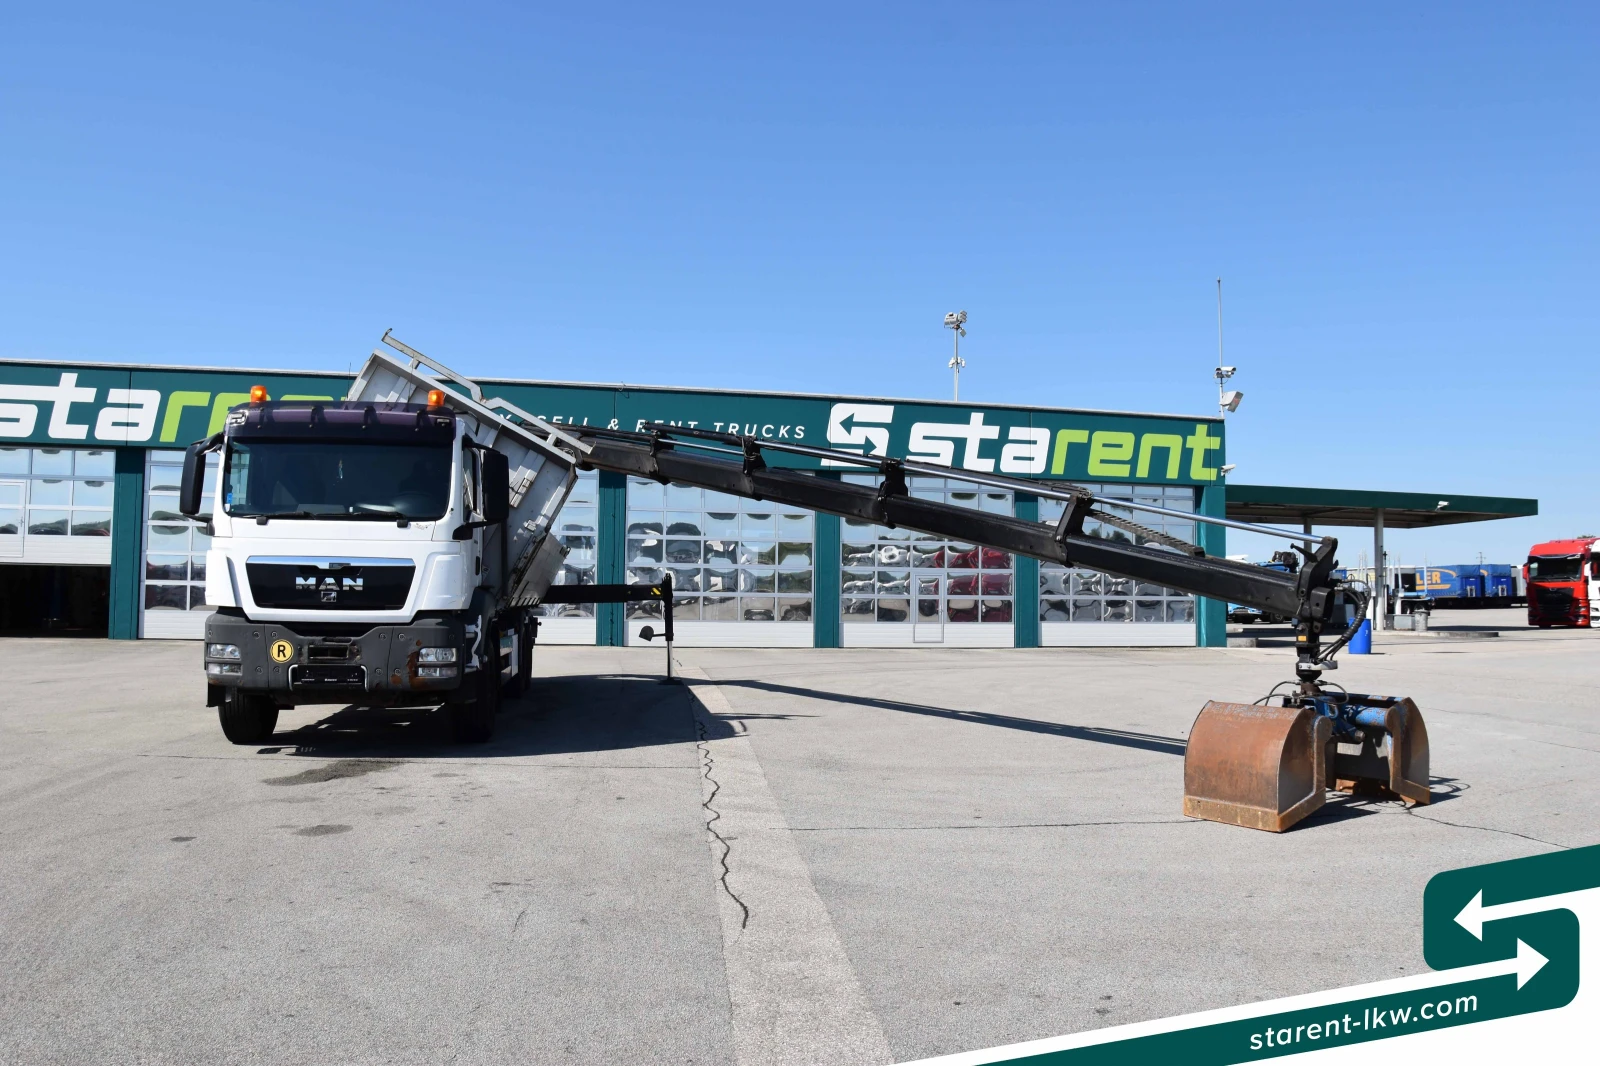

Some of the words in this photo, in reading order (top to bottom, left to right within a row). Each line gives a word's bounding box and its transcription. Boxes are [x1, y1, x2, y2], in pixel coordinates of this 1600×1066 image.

[607, 418, 620, 431] &
[713, 422, 806, 439] TRUCKS
[906, 412, 1222, 481] starent
[295, 576, 364, 591] MAN
[277, 644, 287, 658] R
